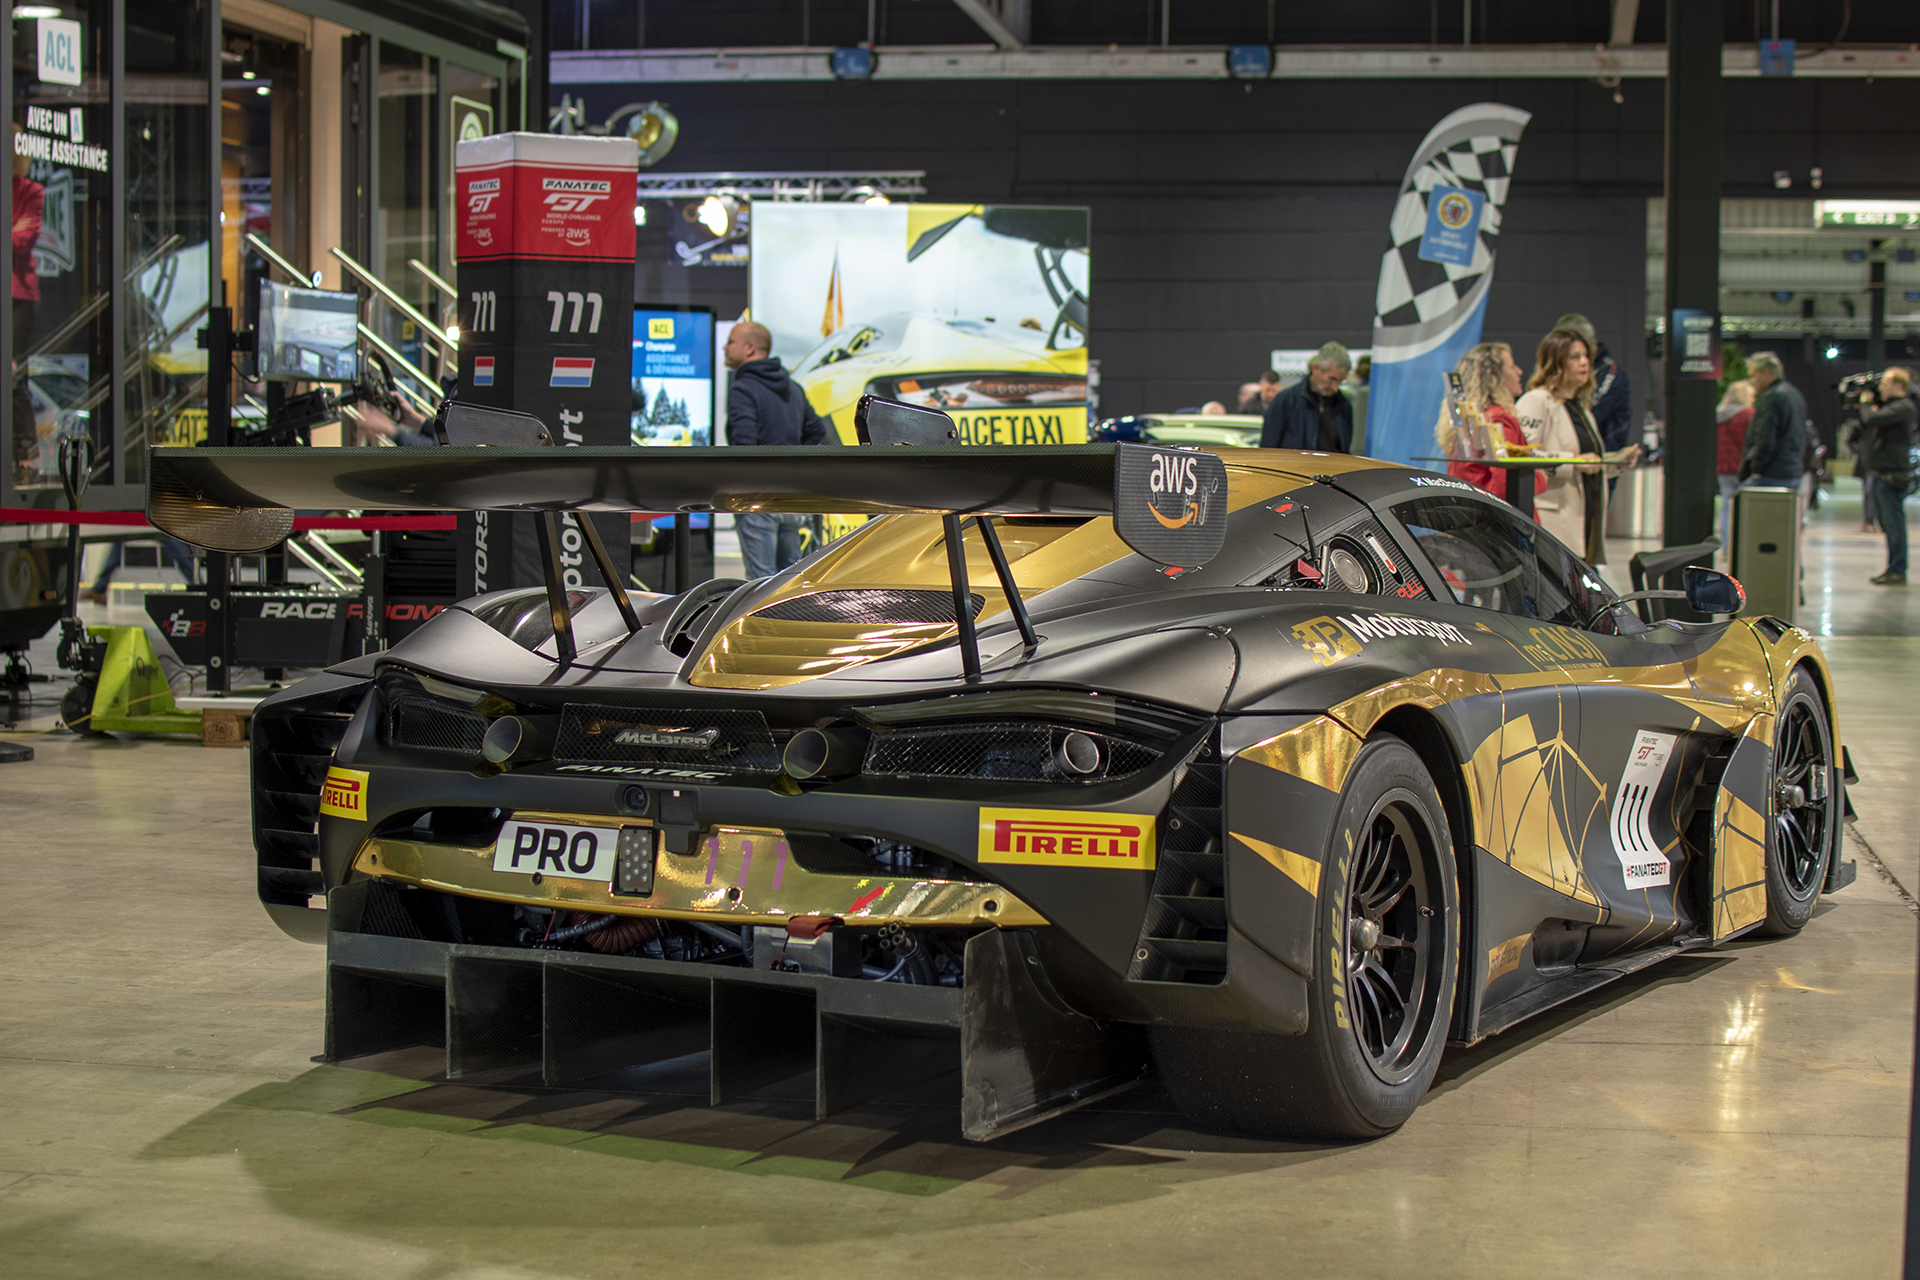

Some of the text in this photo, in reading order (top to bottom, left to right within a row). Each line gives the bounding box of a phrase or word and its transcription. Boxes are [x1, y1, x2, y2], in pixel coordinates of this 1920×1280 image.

[45, 30, 75, 73] ACL
[27, 105, 52, 133] AVEC
[53, 111, 68, 136] UN
[14, 132, 108, 173] COMME ASSISTANCE
[470, 180, 499, 190] FANATEC
[545, 181, 608, 191] FANATEC
[543, 193, 610, 212] GT
[568, 213, 601, 221] CHALLENGE
[566, 228, 589, 239] aws
[653, 324, 669, 334] ACL
[958, 416, 1063, 445] ACETAXI
[1150, 453, 1197, 495] aws
[1396, 579, 1424, 599] PULL
[1335, 613, 1473, 647] Motorsport
[615, 731, 708, 748] McLaren
[557, 764, 730, 779] FANATEC
[1617, 783, 1649, 852] 111
[511, 826, 598, 874] PRO
[994, 819, 1141, 858] PIRELLI
